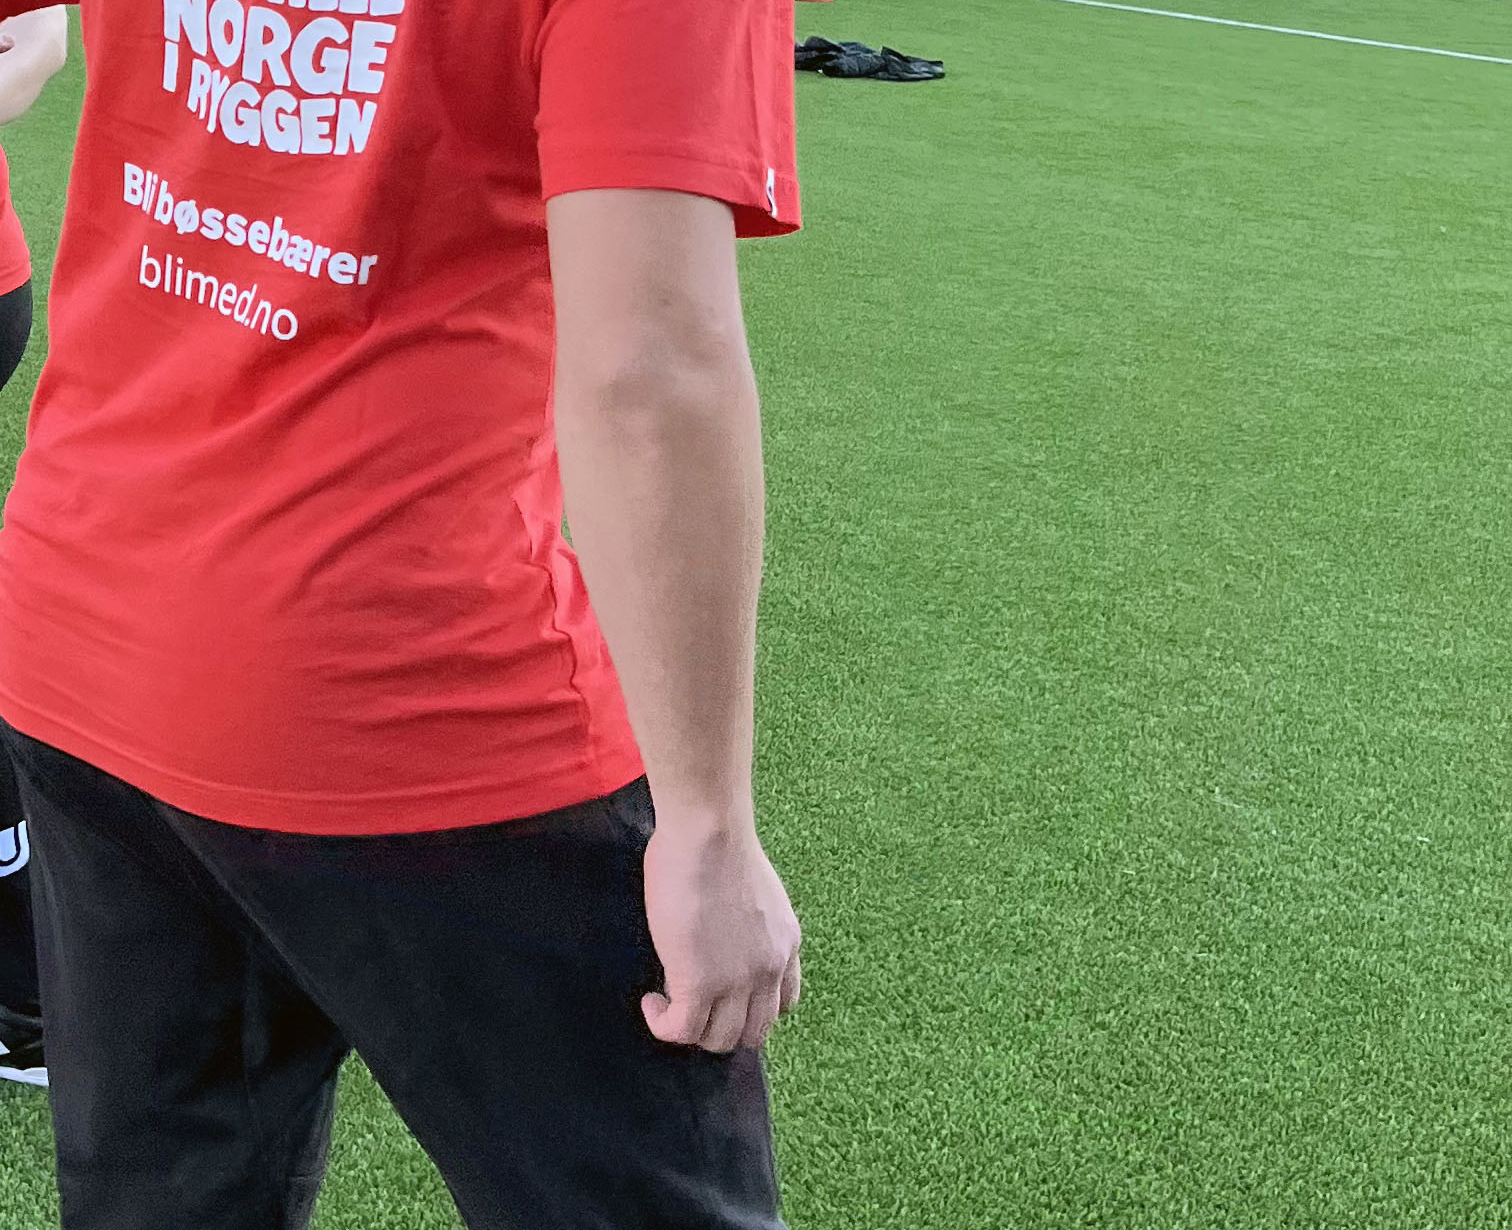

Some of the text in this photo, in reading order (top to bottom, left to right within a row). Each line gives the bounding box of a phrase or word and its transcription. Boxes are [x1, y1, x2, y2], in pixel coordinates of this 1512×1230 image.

[162, 41, 377, 155] I RYGGEN
[123, 162, 378, 285] Bli bøssebærer
[139, 245, 298, 341] blimed.no
